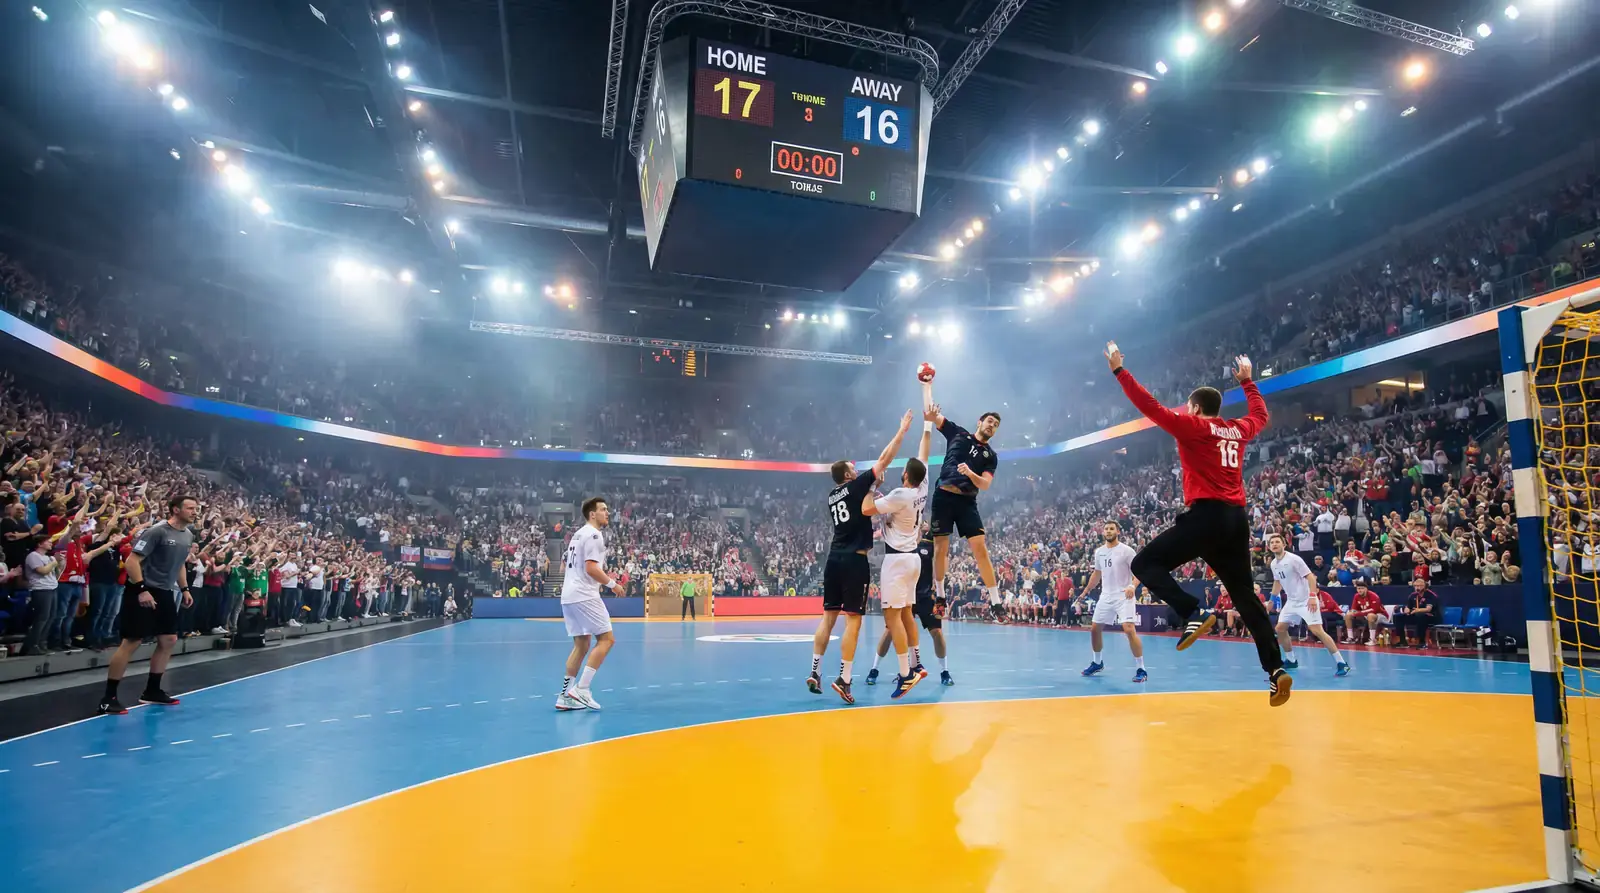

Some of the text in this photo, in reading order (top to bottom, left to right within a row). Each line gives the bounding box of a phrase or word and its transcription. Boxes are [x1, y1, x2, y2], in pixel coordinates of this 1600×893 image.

[707, 46, 766, 75] HOME
[714, 77, 761, 118] 17
[851, 76, 902, 102] AWAY
[856, 105, 899, 144] 16
[735, 168, 742, 179] 0
[777, 148, 837, 177] 00:00
[1216, 439, 1239, 468] 16
[831, 500, 850, 526] 18
[1104, 558, 1113, 568] 16
